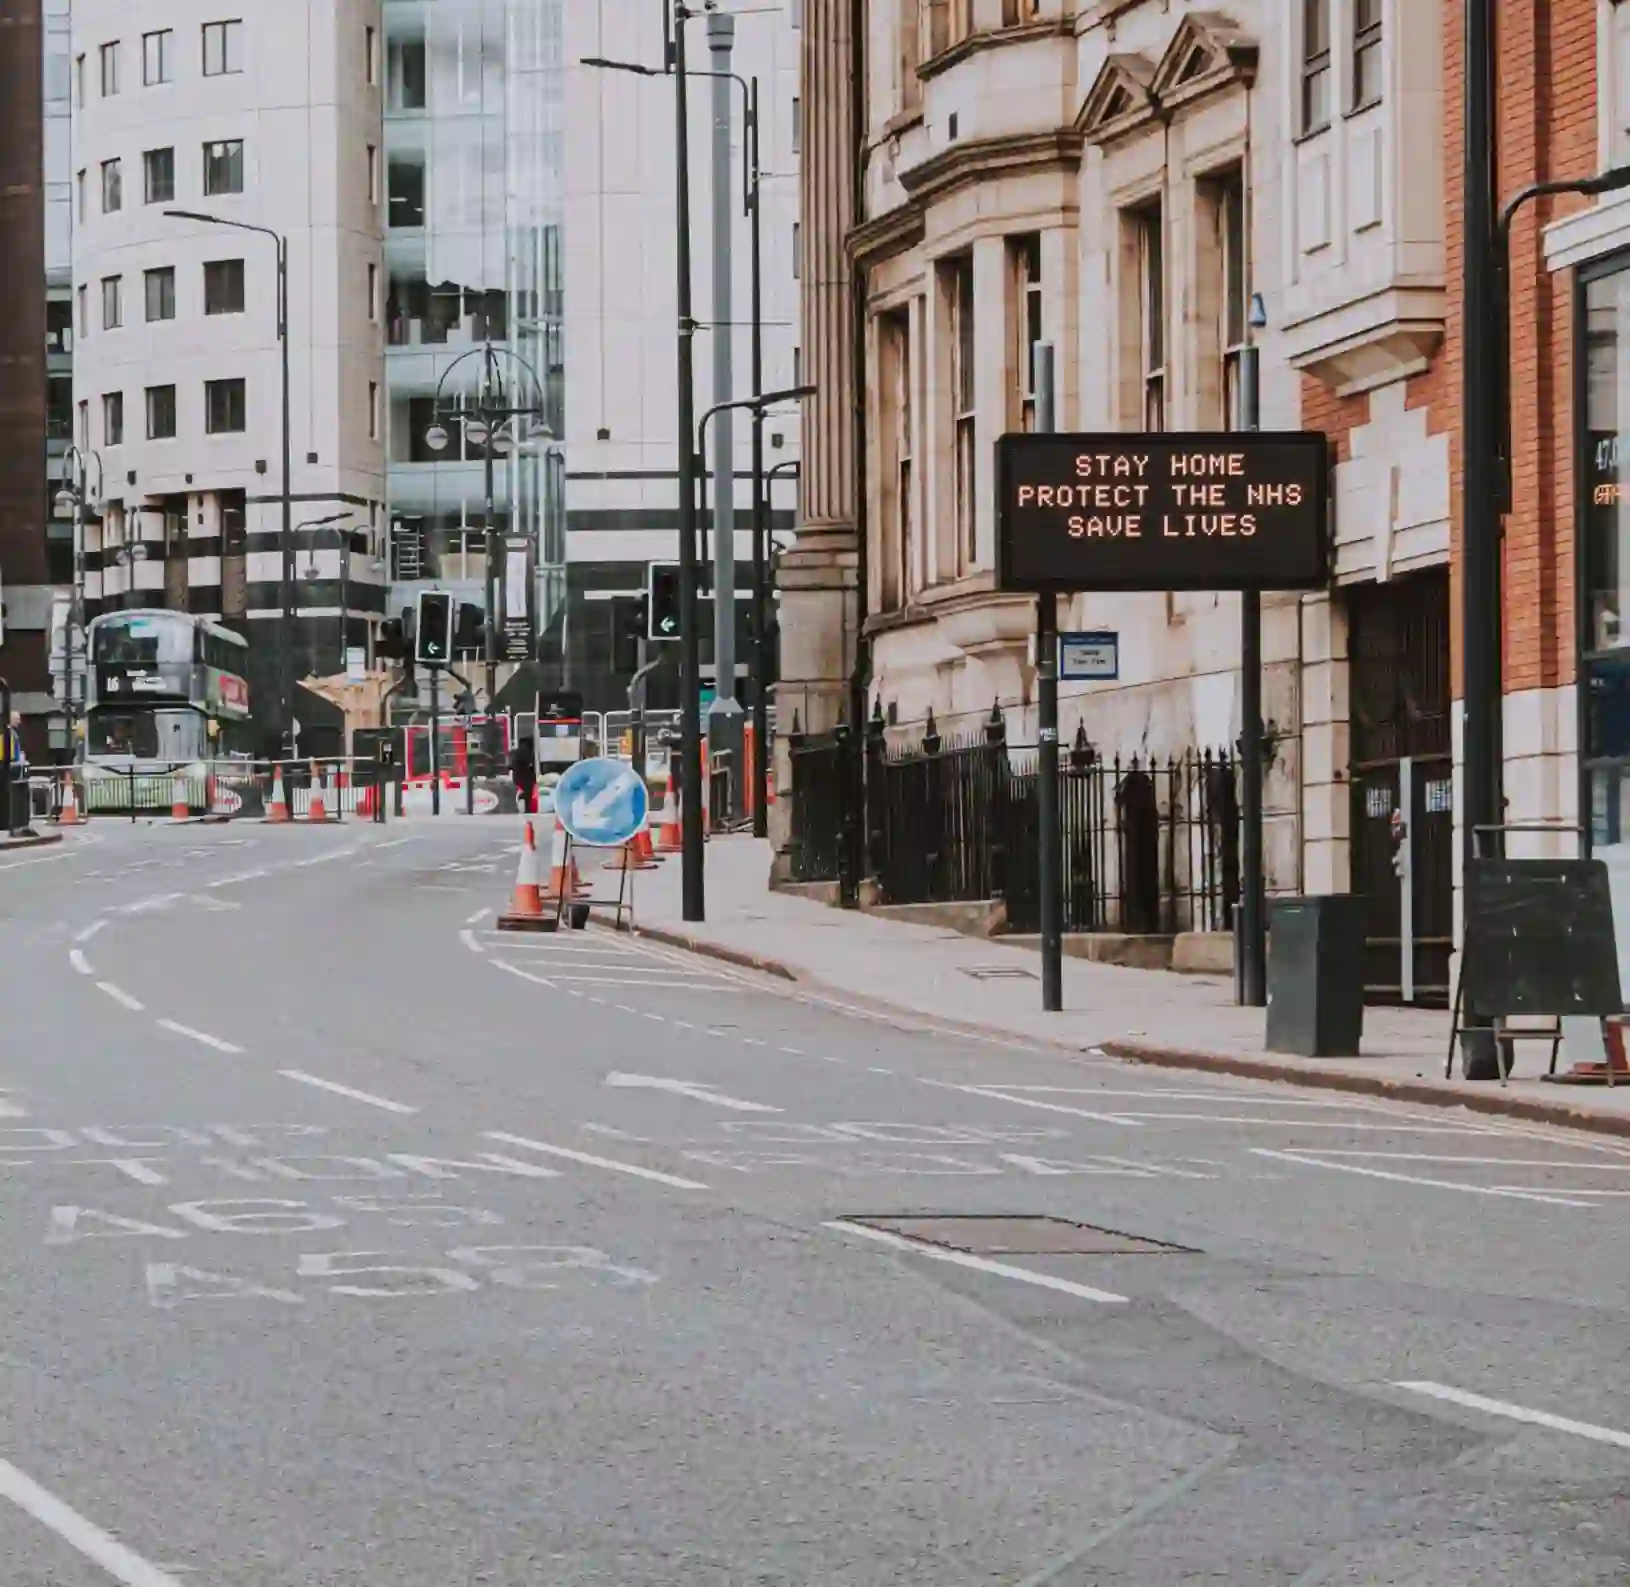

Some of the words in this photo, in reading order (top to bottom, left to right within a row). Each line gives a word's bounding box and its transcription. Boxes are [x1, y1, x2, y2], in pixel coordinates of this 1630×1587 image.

[1075, 454, 1149, 476] STAY
[1170, 453, 1245, 476] HOME
[1018, 484, 1149, 507] PROTECT
[1171, 484, 1226, 506] THE
[1247, 483, 1302, 506] NHS
[1067, 515, 1142, 537] SAVE
[1163, 514, 1257, 537] LIVES
[145, 1244, 660, 1307] A58
